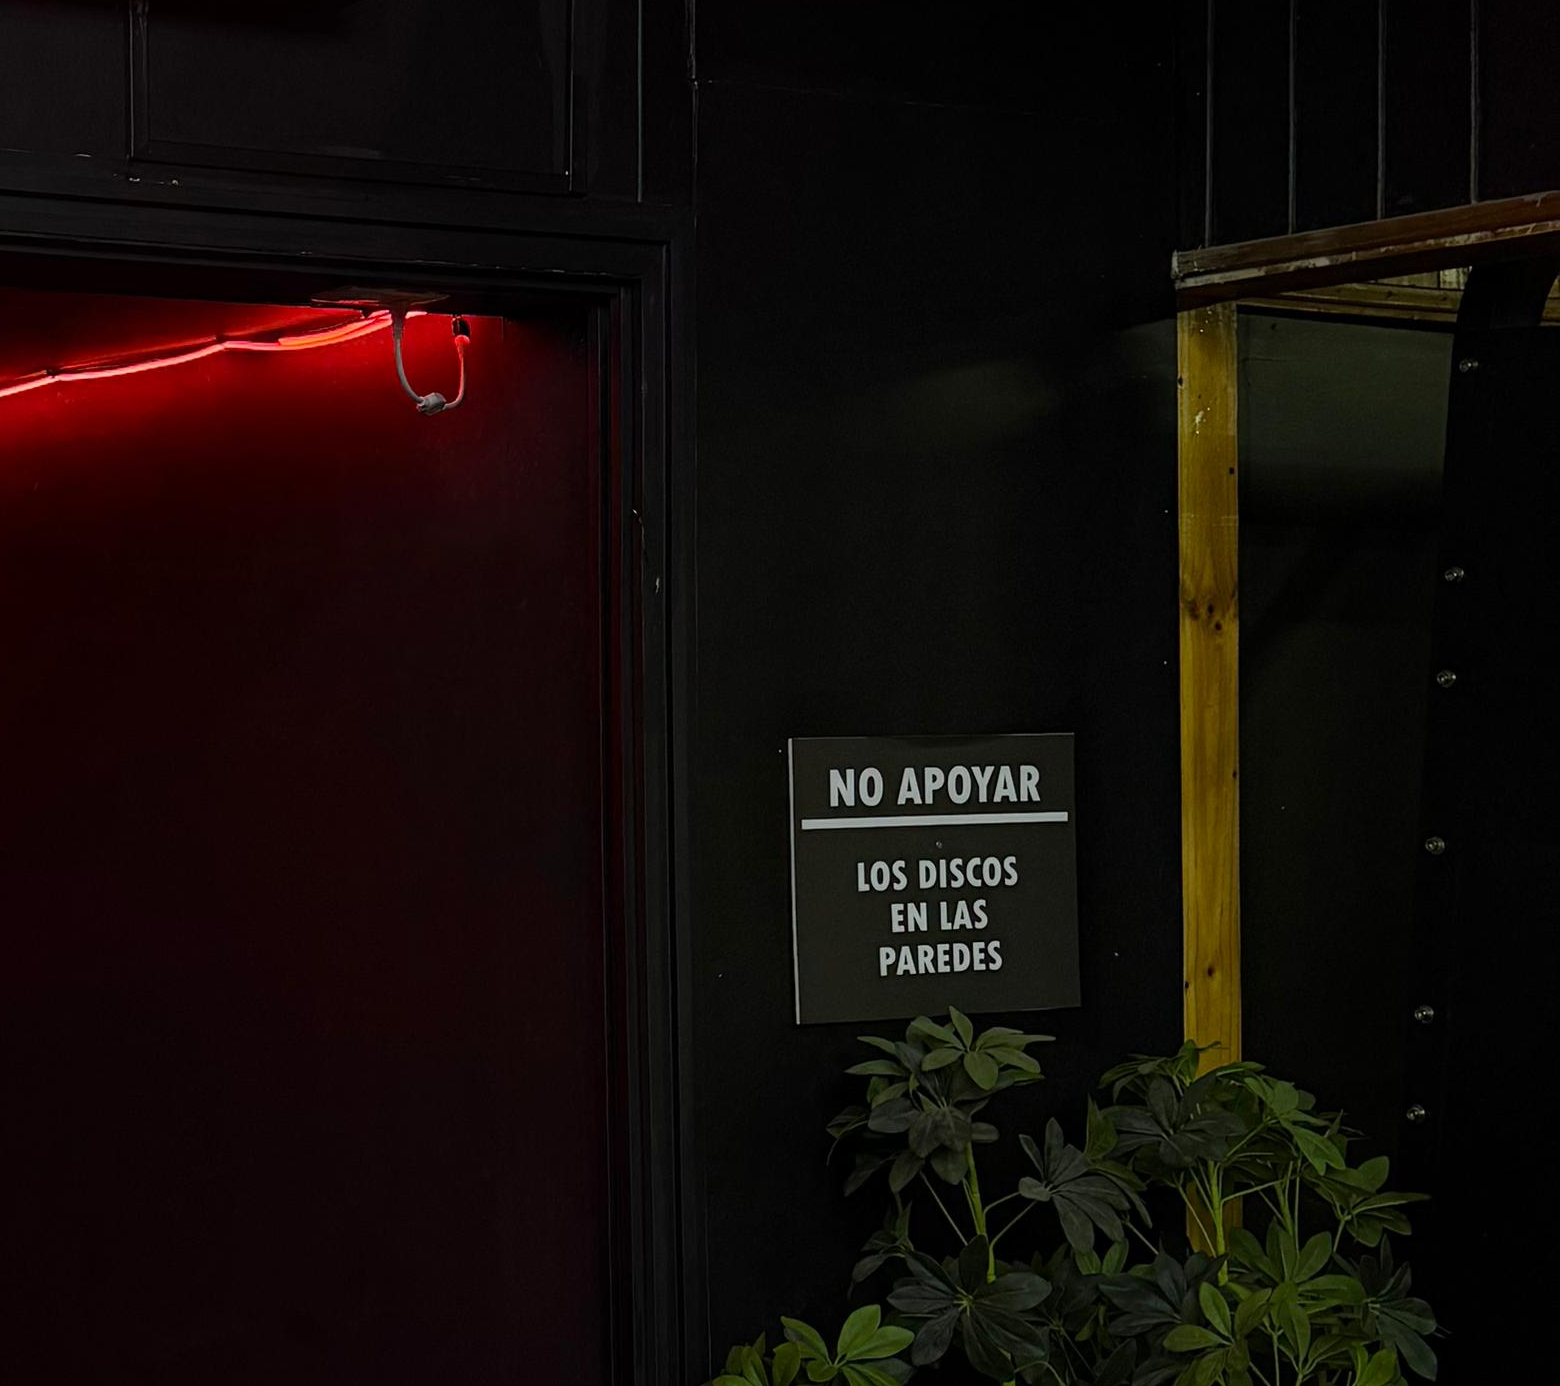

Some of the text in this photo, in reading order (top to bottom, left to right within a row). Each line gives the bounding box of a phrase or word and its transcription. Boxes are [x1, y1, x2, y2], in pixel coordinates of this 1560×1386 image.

[829, 765, 1041, 808] NO APOYAR
[857, 856, 1019, 892] LOS DISCOS
[890, 899, 988, 933] EN LAS
[879, 940, 1003, 977] PAREDES
